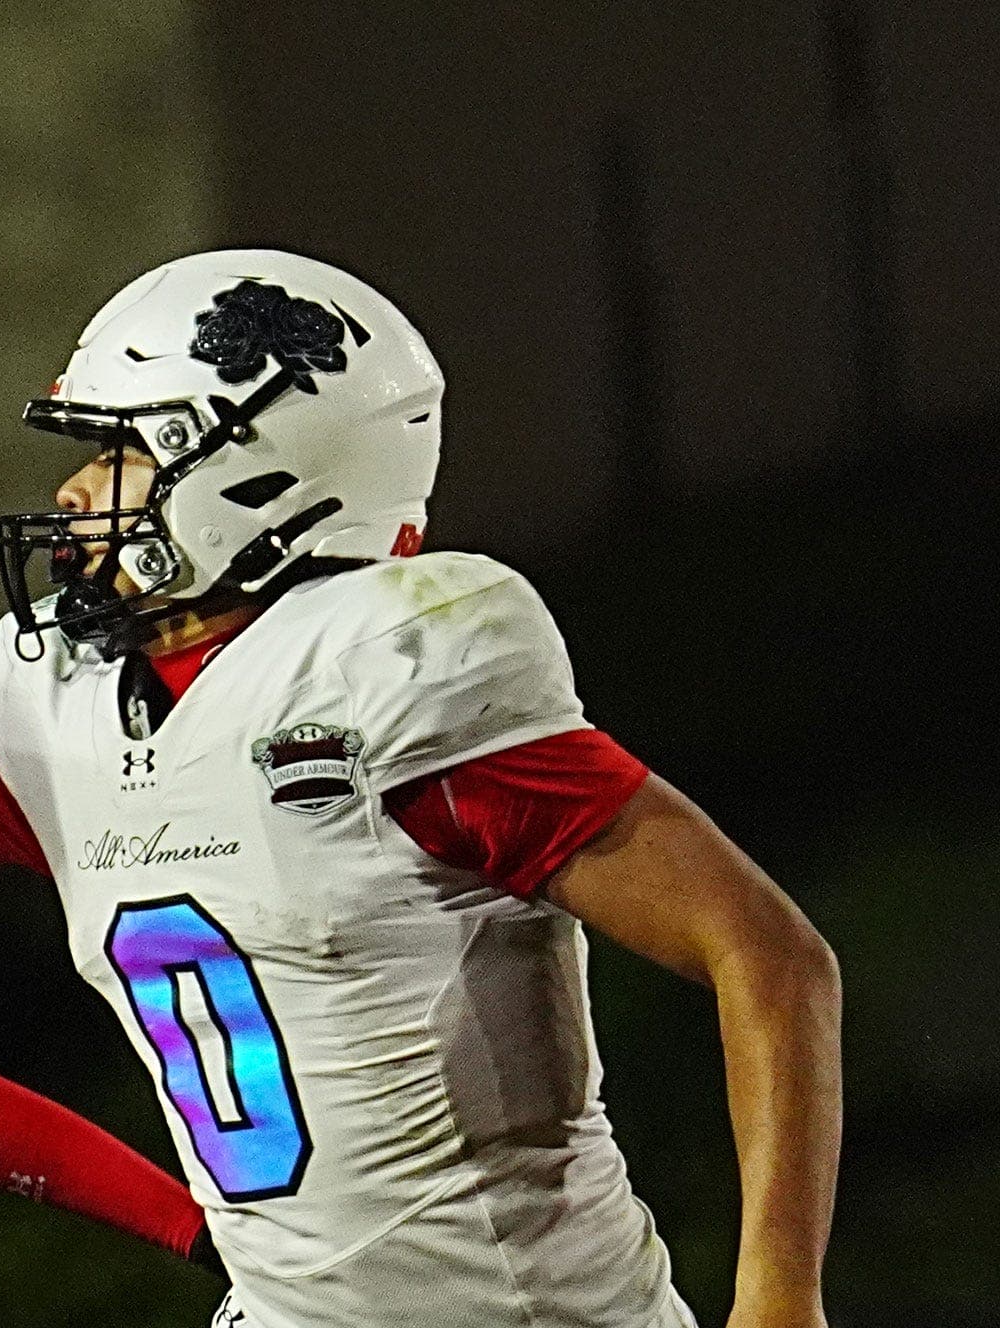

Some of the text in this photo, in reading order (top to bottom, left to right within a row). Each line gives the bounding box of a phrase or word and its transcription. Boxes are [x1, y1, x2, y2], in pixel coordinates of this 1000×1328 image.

[272, 763, 346, 783] UNDER ARMOUR
[104, 893, 313, 1202] 0
